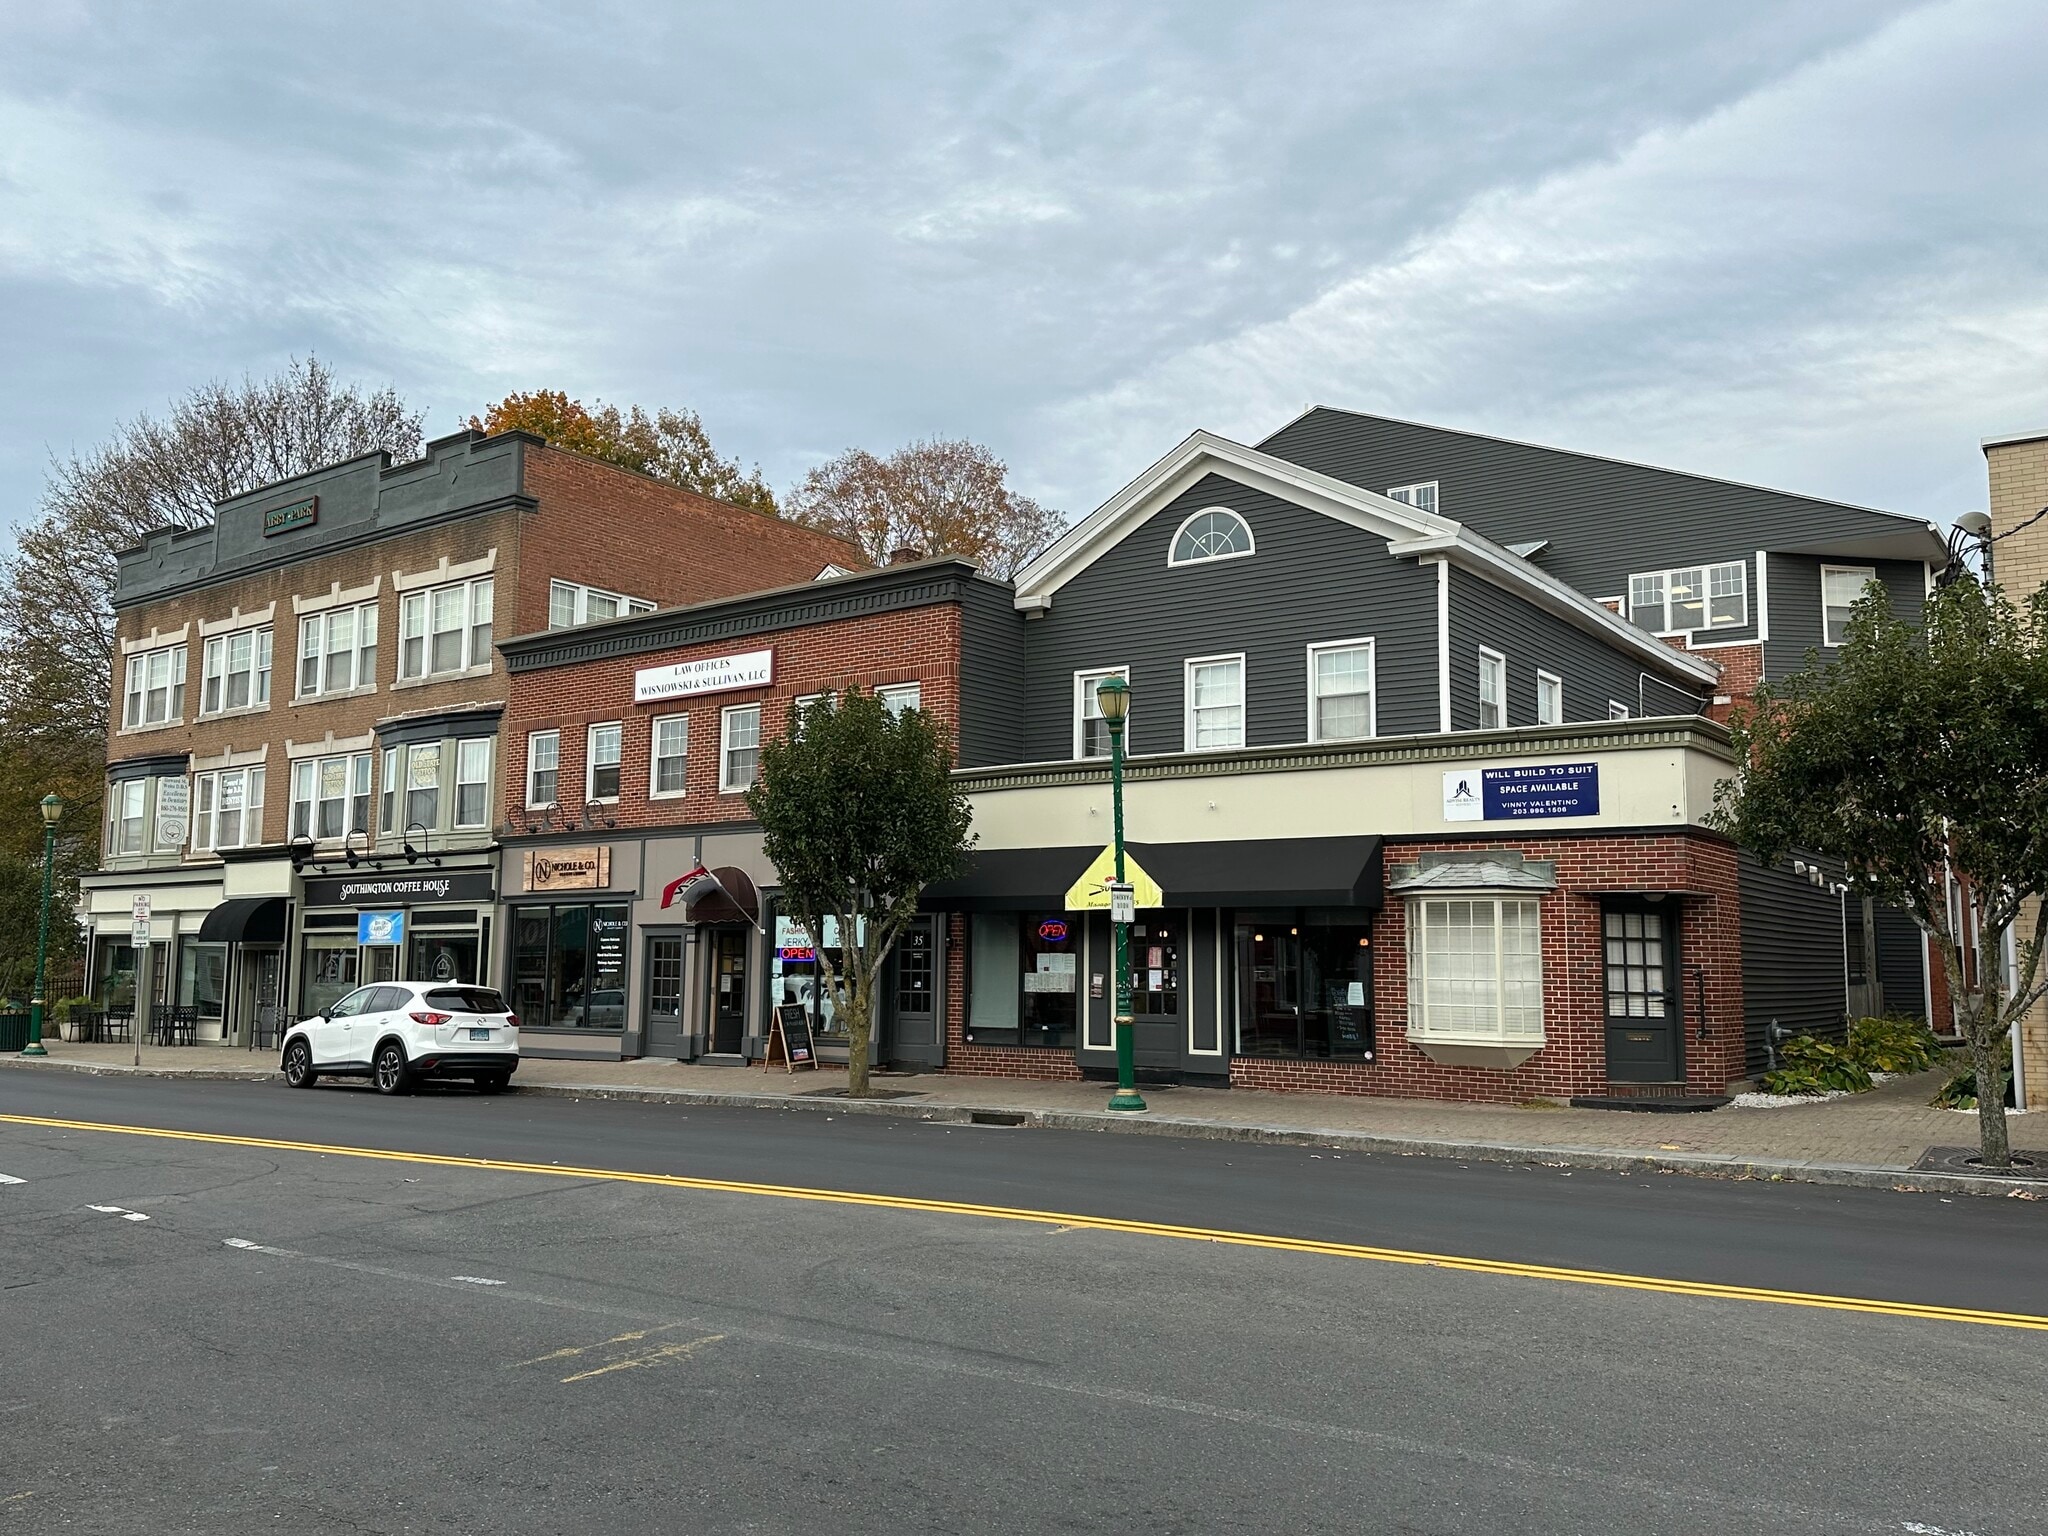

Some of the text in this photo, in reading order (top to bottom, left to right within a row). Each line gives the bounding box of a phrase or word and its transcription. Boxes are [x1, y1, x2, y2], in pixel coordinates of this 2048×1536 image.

[290, 504, 313, 521] PARK
[674, 659, 730, 676] LAW OFFICES
[640, 669, 767, 696] WISNIOWSKI & SULLIVAN, LLC
[1514, 768, 1546, 778] BUILD
[1568, 766, 1593, 774] SUIT
[1500, 782, 1578, 794] SPACE AVAILABLE
[1530, 799, 1578, 807] VALENTINO
[552, 862, 578, 872] NICHOLE
[578, 861, 584, 870] &
[340, 880, 450, 900] SOUTHINGTON COFFEE HOUSE
[1038, 924, 1068, 937] OPEN
[913, 935, 924, 946] 35
[782, 948, 813, 959] OPEN
